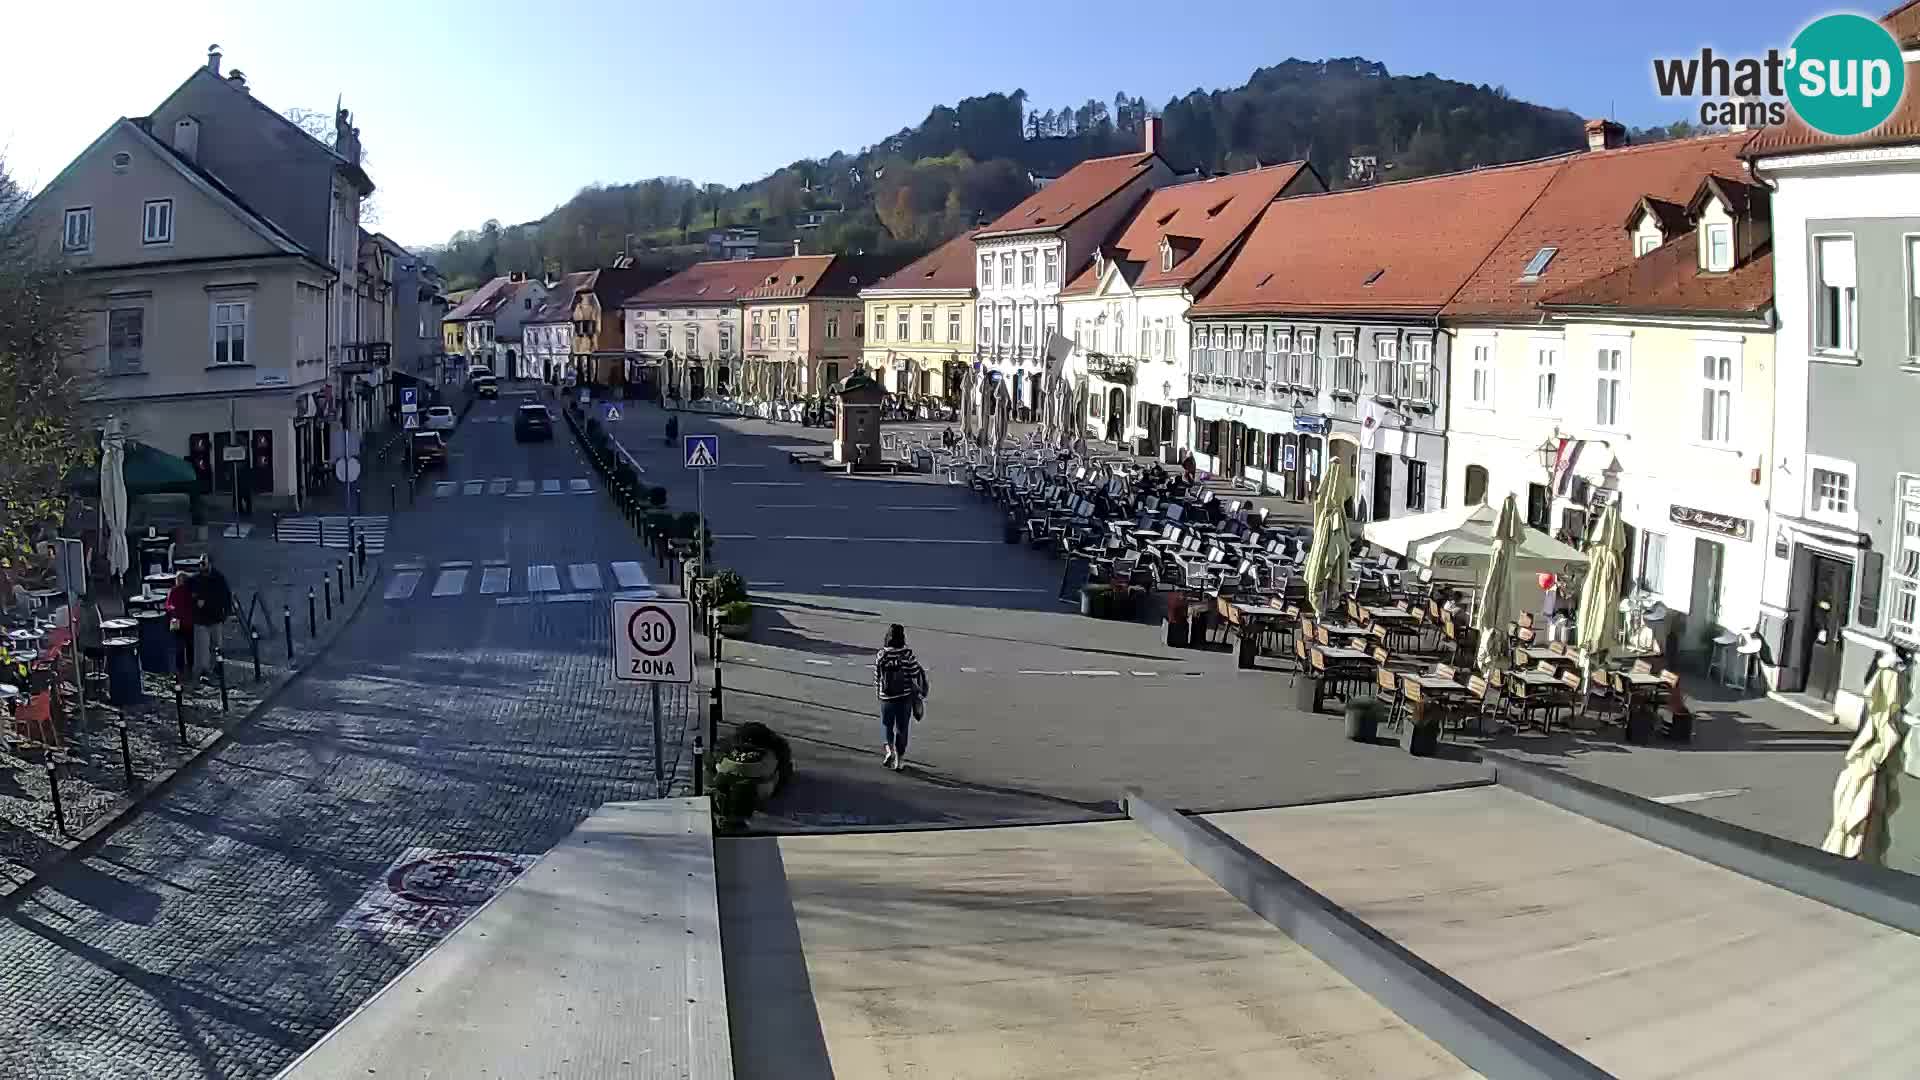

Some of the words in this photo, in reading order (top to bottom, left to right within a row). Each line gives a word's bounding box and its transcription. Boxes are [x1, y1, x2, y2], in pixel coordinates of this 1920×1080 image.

[405, 391, 413, 402] P
[640, 621, 665, 643] 30
[631, 658, 675, 676] ZONA
